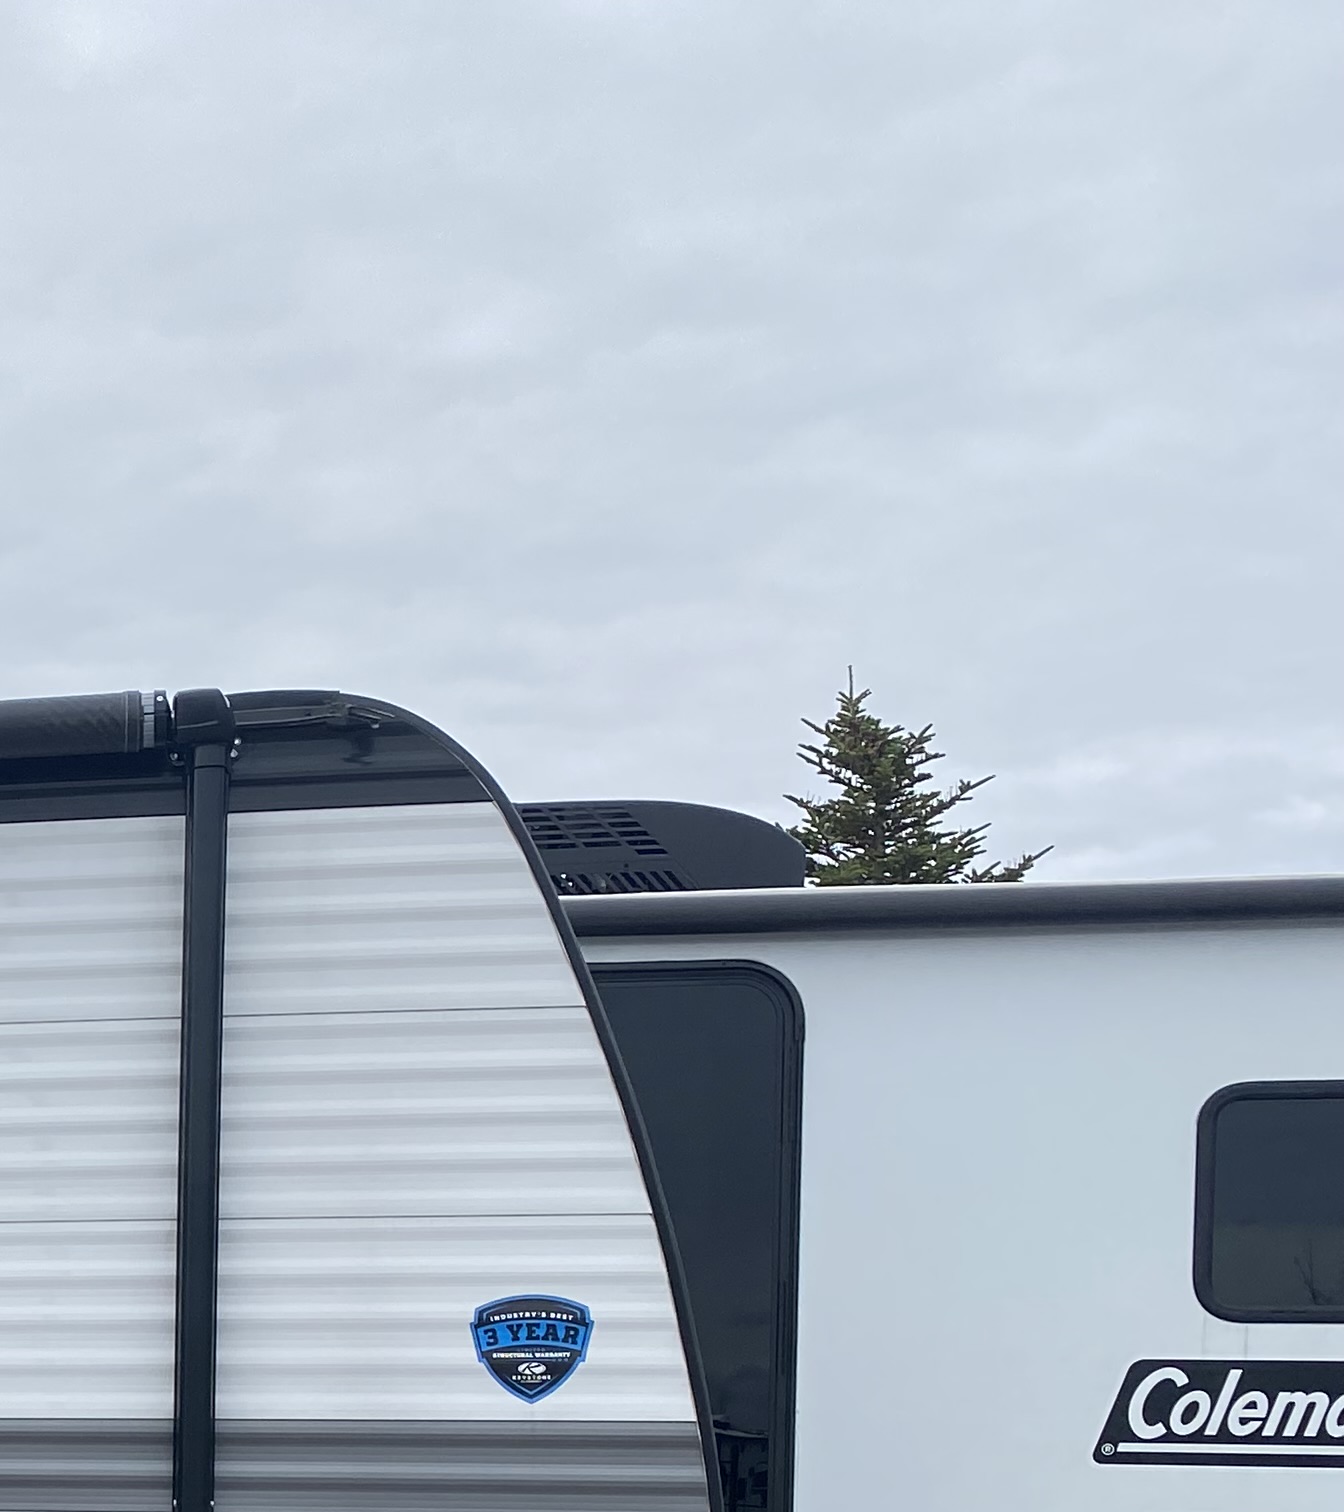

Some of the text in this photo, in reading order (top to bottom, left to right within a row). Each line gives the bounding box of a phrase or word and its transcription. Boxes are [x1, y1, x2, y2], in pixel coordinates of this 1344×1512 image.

[489, 1311, 574, 1322] INDUSTRY'S BEST
[483, 1322, 580, 1347] 3 YEAR
